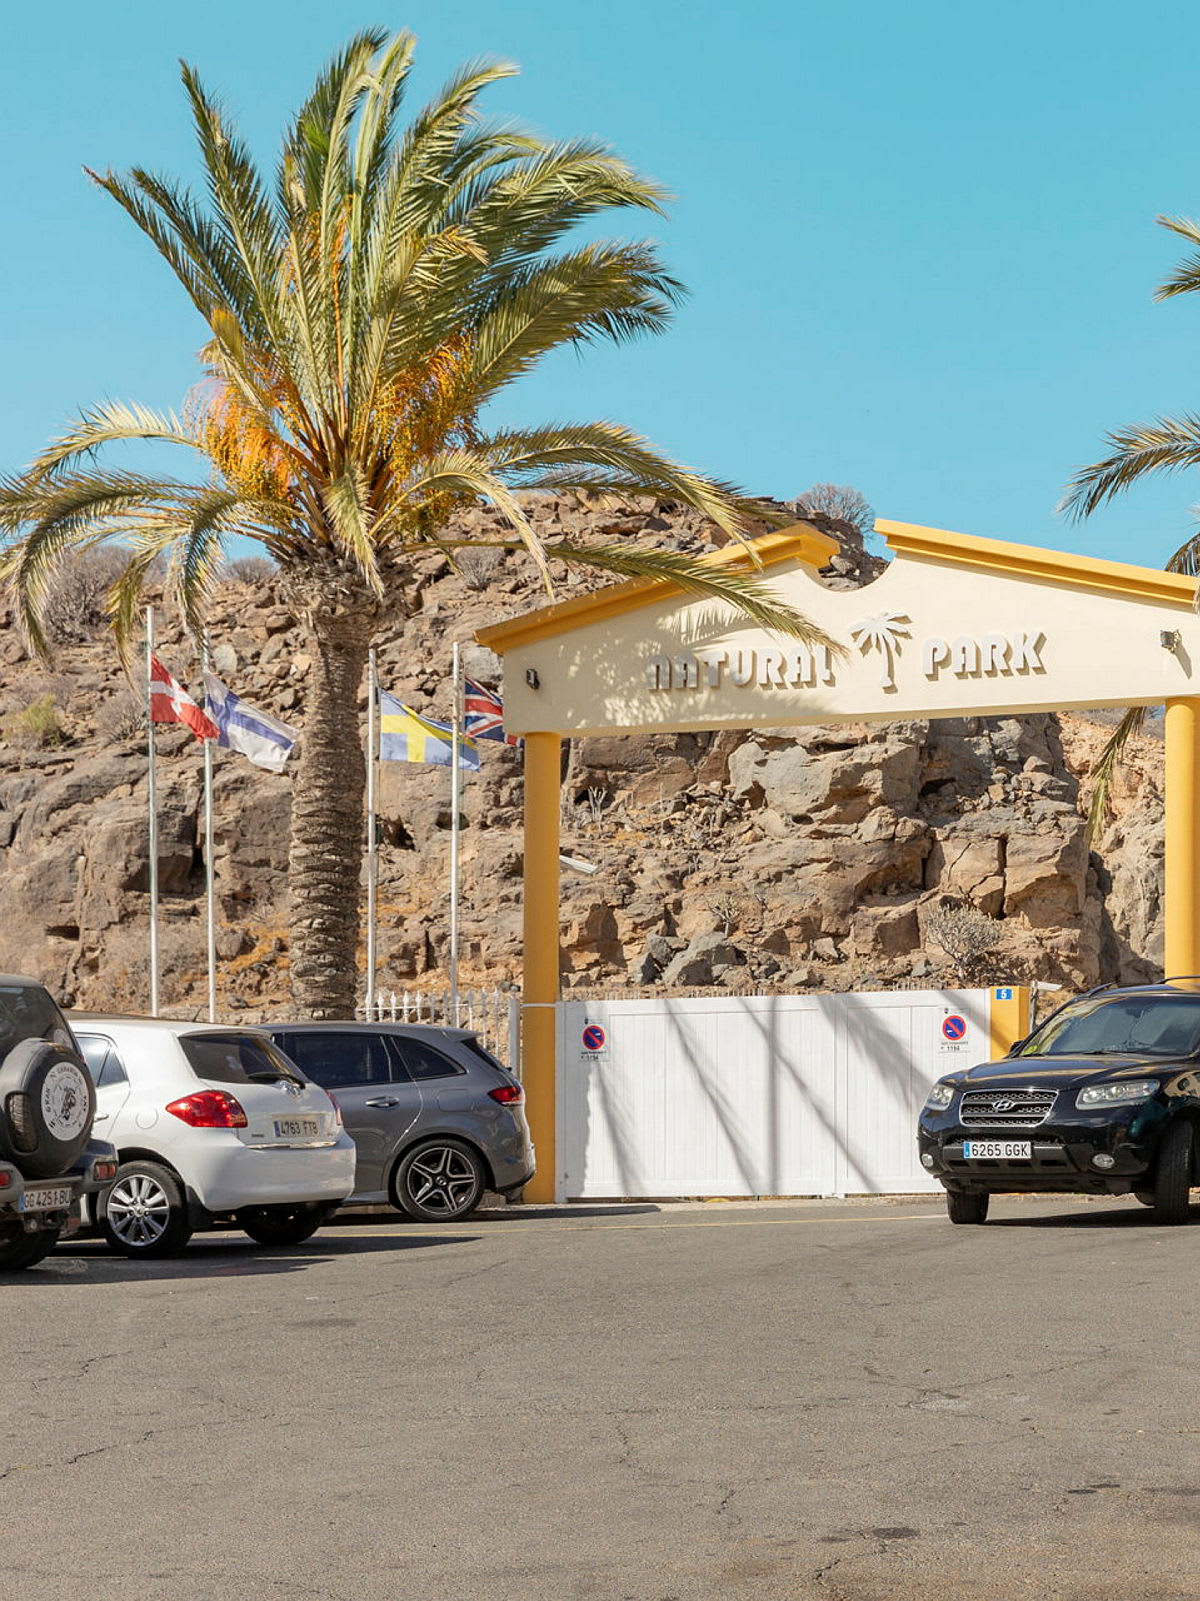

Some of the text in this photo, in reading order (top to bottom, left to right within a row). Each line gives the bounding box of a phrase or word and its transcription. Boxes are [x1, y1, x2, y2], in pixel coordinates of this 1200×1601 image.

[646, 631, 1047, 690] NATURAL PARK
[281, 1121, 318, 1134] 4763 FTB
[972, 1144, 1028, 1156] 6265 GGK
